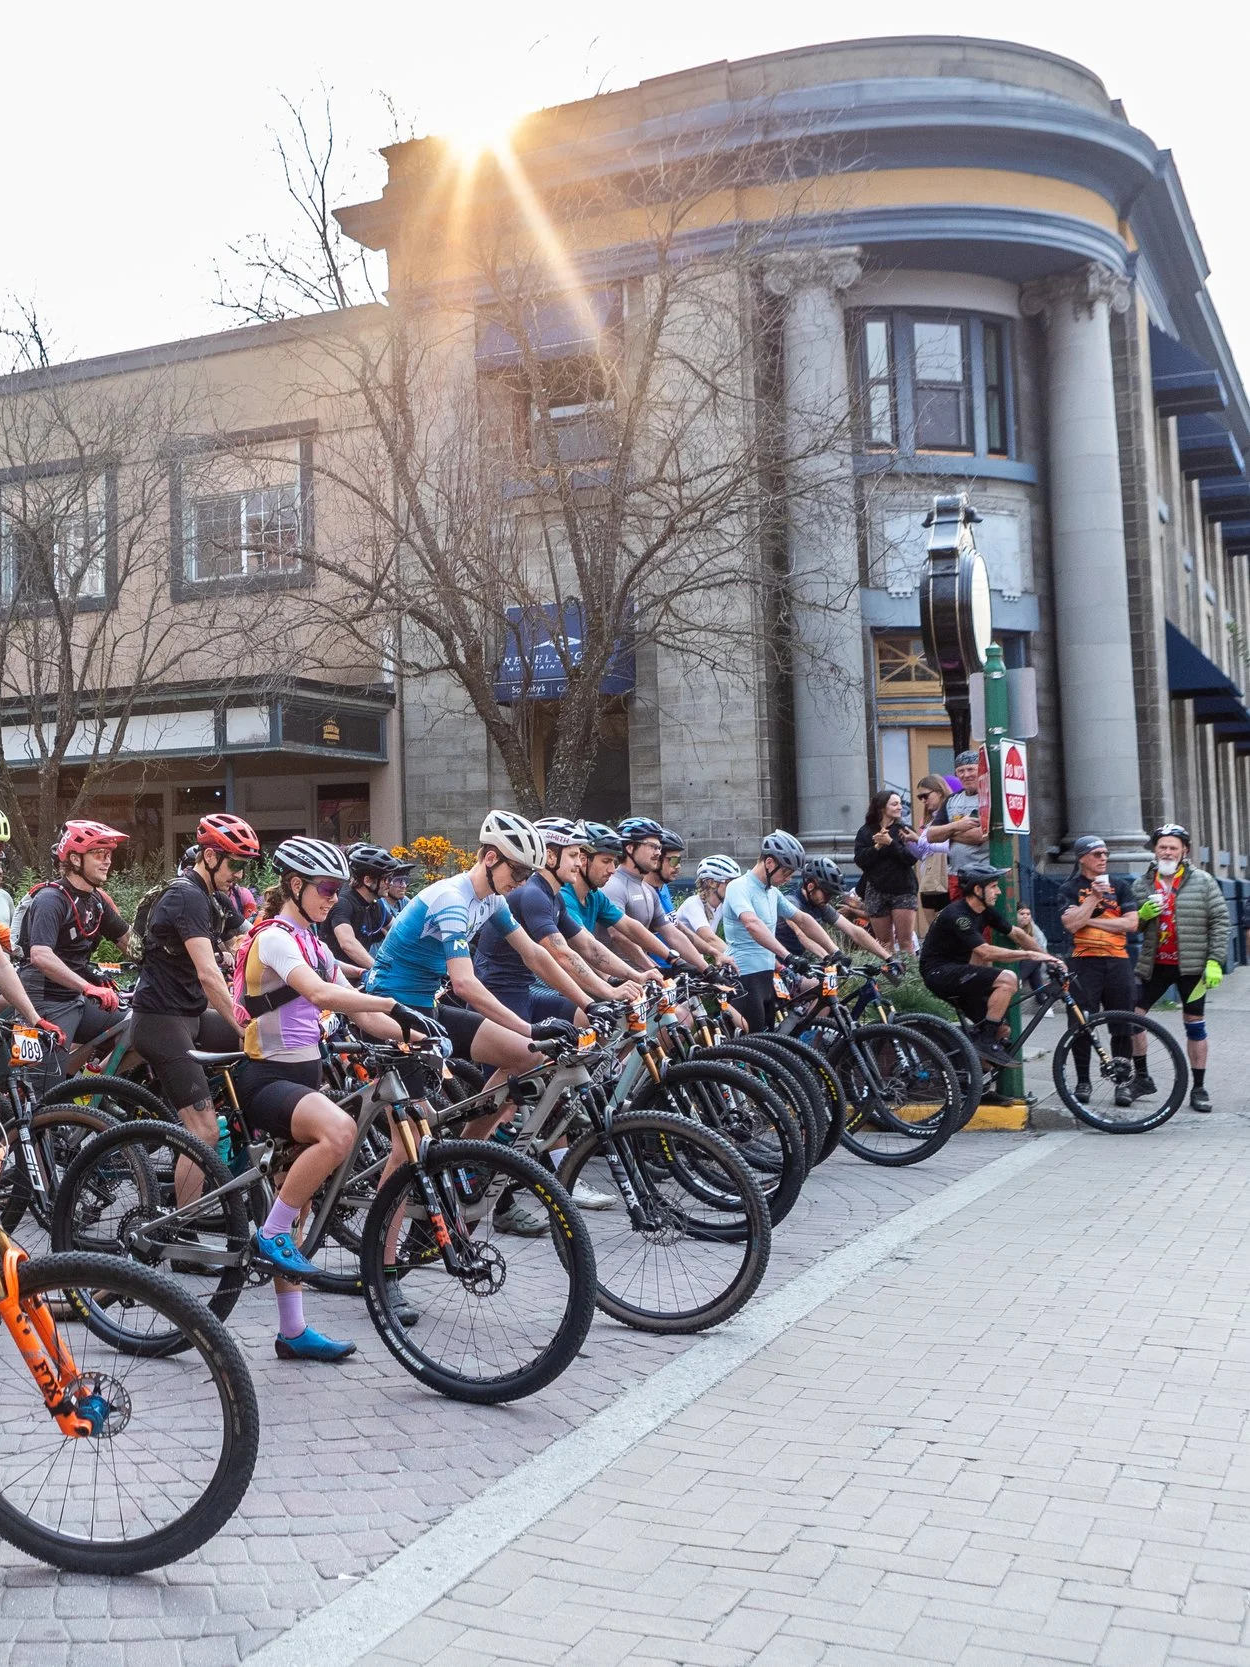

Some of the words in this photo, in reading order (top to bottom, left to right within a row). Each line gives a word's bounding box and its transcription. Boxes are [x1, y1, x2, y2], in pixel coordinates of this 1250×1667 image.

[545, 832, 570, 844] SMITH
[21, 1039, 41, 1061] 089
[534, 1183, 574, 1240] MAXXIS
